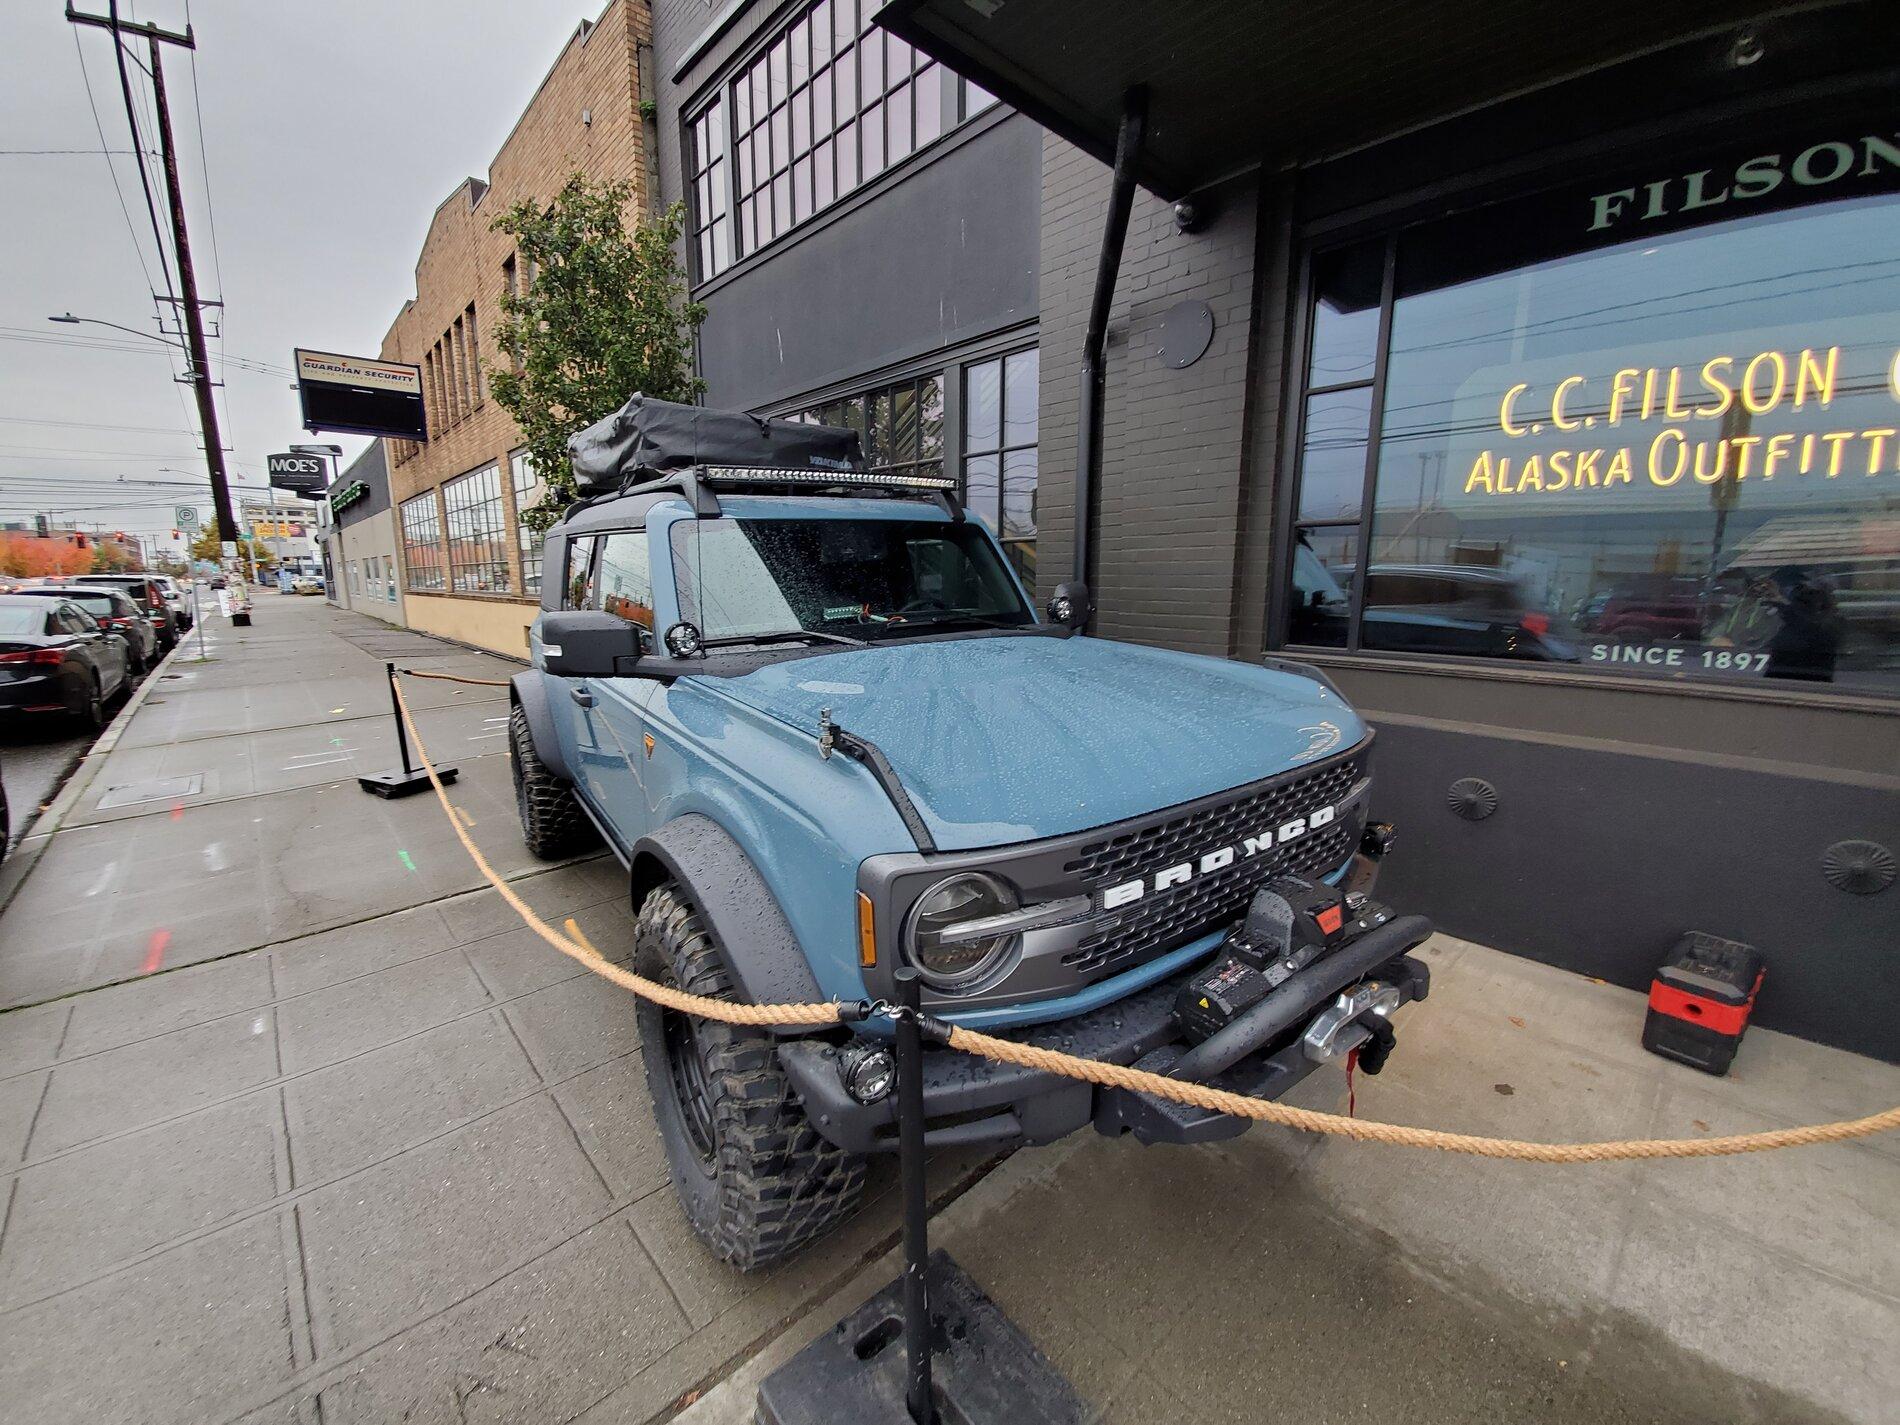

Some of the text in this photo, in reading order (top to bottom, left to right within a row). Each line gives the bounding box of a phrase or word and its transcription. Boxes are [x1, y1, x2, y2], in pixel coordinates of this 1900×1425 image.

[1586, 133, 1900, 232] FILSON
[303, 362, 361, 375] GUARDIAN
[364, 370, 414, 383] SECURITY
[1607, 346, 1842, 429] FILSON
[270, 458, 320, 473] MOE'S
[1464, 427, 1900, 495] ALASKA OUTFITT
[1590, 643, 1771, 672] SINCE 1897
[1104, 805, 1335, 910] BRONCO
